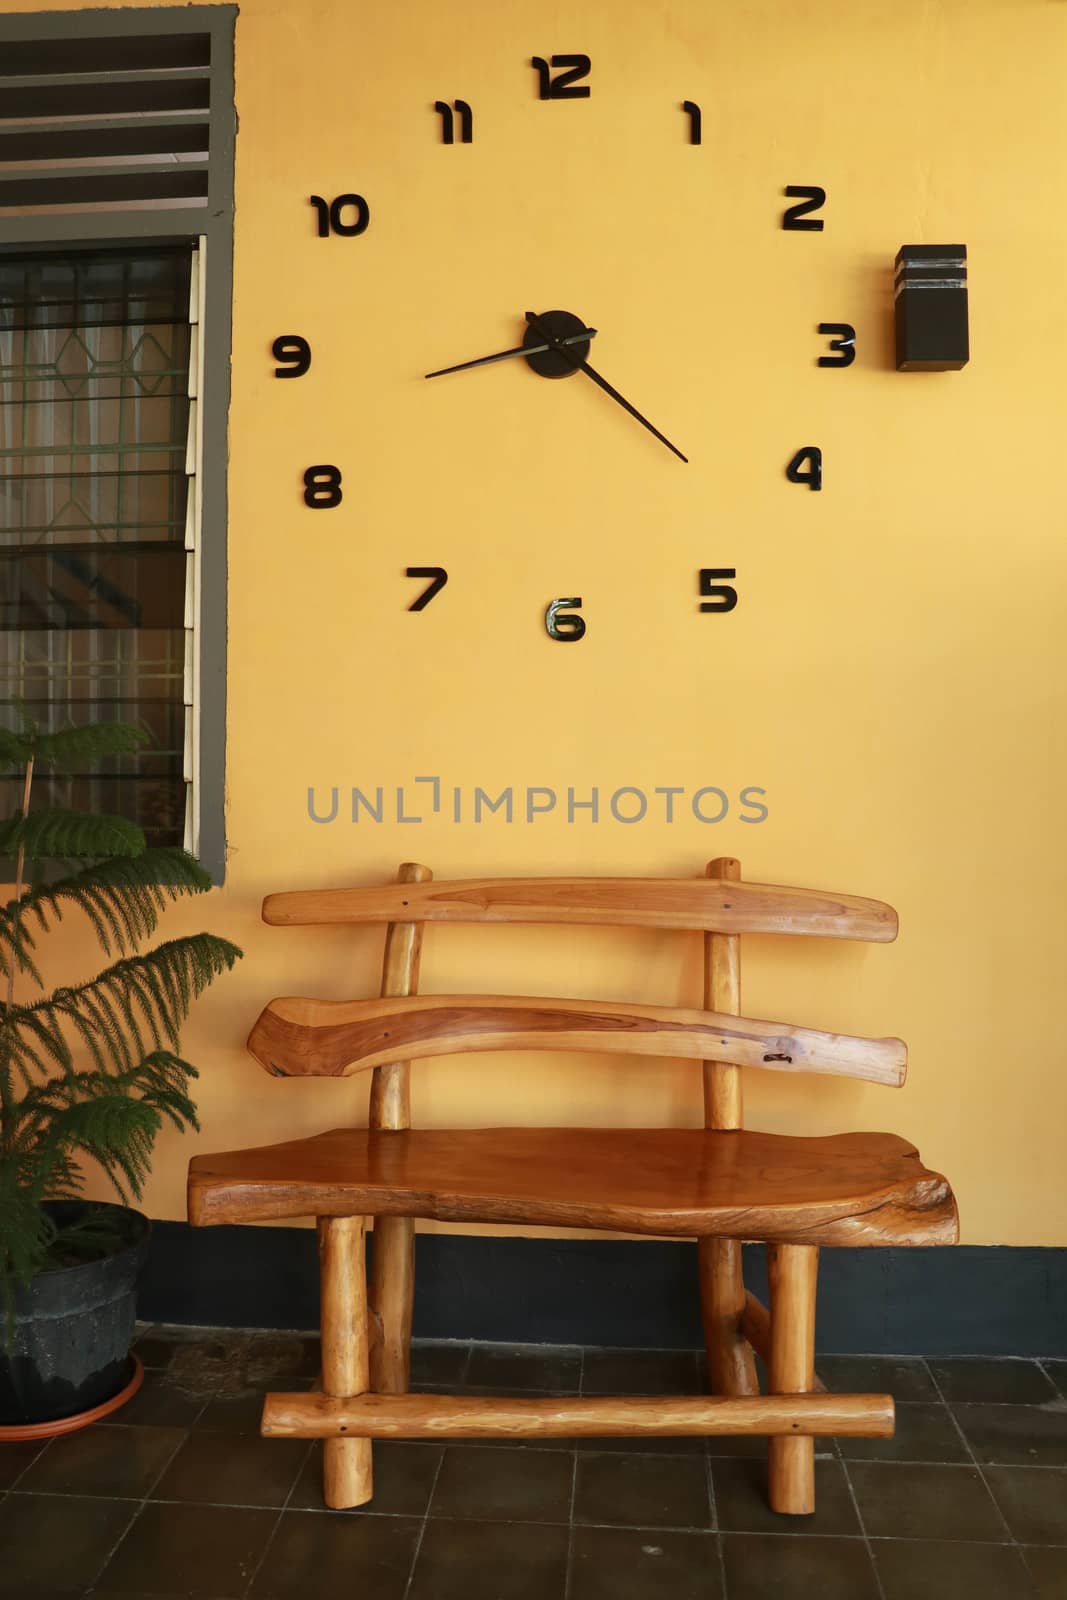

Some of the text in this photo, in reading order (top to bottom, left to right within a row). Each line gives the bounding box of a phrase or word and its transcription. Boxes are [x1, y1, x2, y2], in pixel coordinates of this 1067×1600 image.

[531, 55, 591, 100] 12
[435, 100, 473, 144] 11
[683, 100, 702, 145] 1
[310, 194, 369, 237] 10
[782, 186, 826, 231] 2
[272, 335, 311, 378] 9
[818, 323, 857, 368] 3
[303, 465, 342, 509] 8
[786, 447, 822, 491] 4
[406, 567, 448, 611] 7
[699, 568, 738, 612] 5
[544, 598, 586, 642] 6
